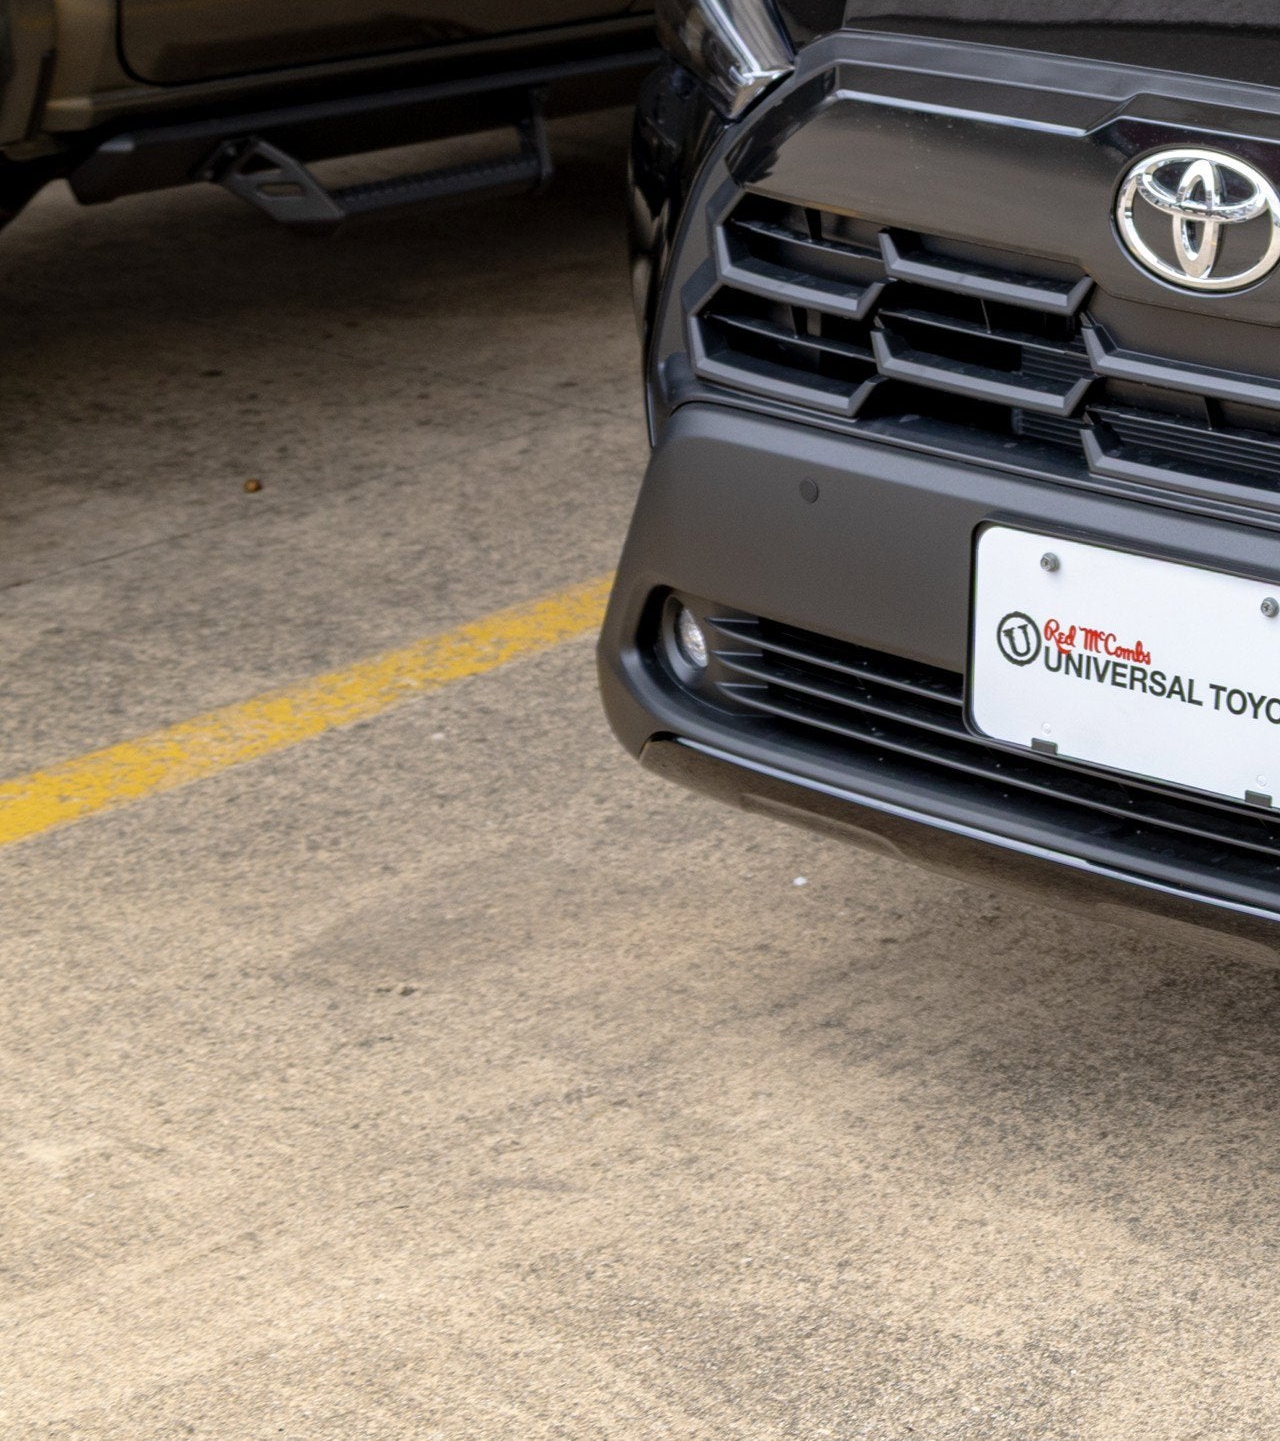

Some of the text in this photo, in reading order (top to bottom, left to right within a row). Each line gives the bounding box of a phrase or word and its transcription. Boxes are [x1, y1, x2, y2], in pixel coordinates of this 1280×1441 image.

[1044, 618, 1151, 665] Red McCombs
[1044, 645, 1203, 707] UNIVERSAL
